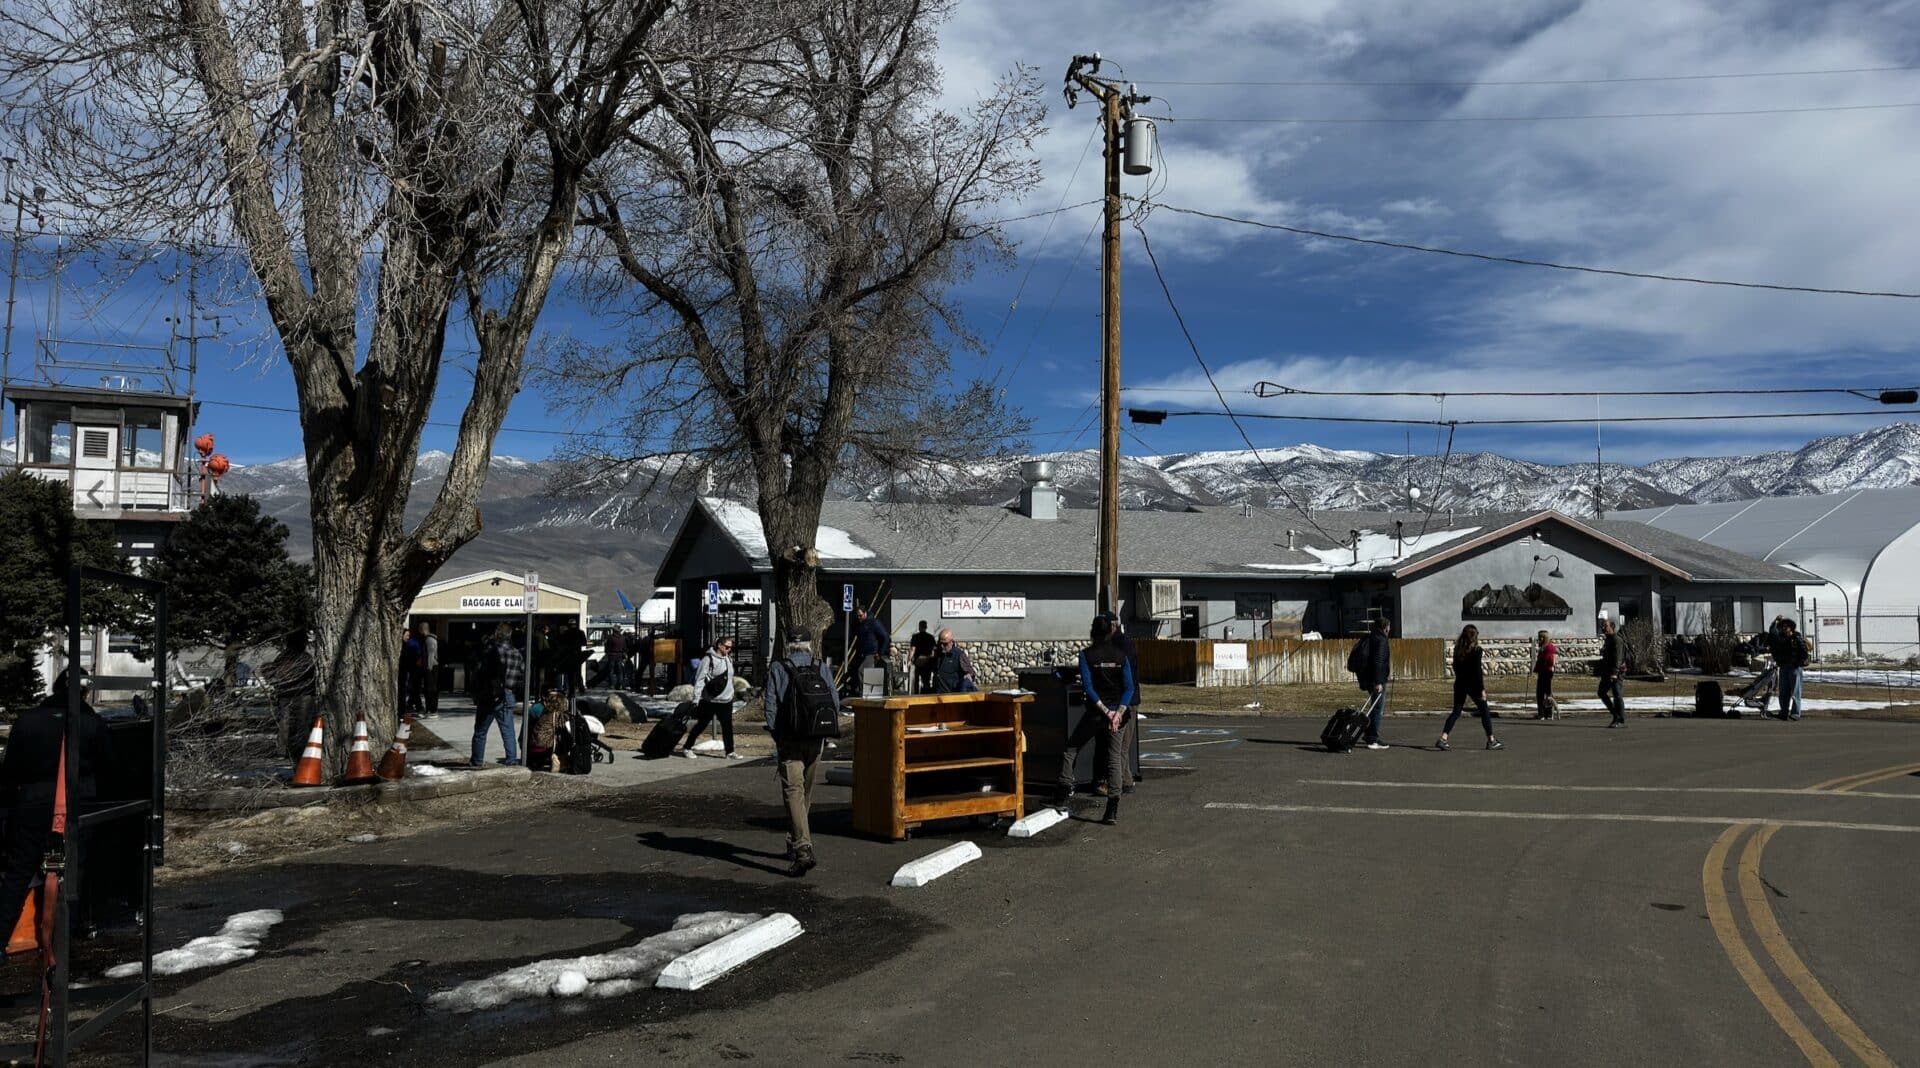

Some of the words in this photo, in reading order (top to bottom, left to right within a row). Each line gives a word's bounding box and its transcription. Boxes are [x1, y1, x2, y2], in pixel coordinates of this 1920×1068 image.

[462, 598, 501, 607] BAGGAGE
[504, 598, 523, 607] CLAI
[945, 599, 974, 610] THAI
[996, 599, 1024, 610] THAI
